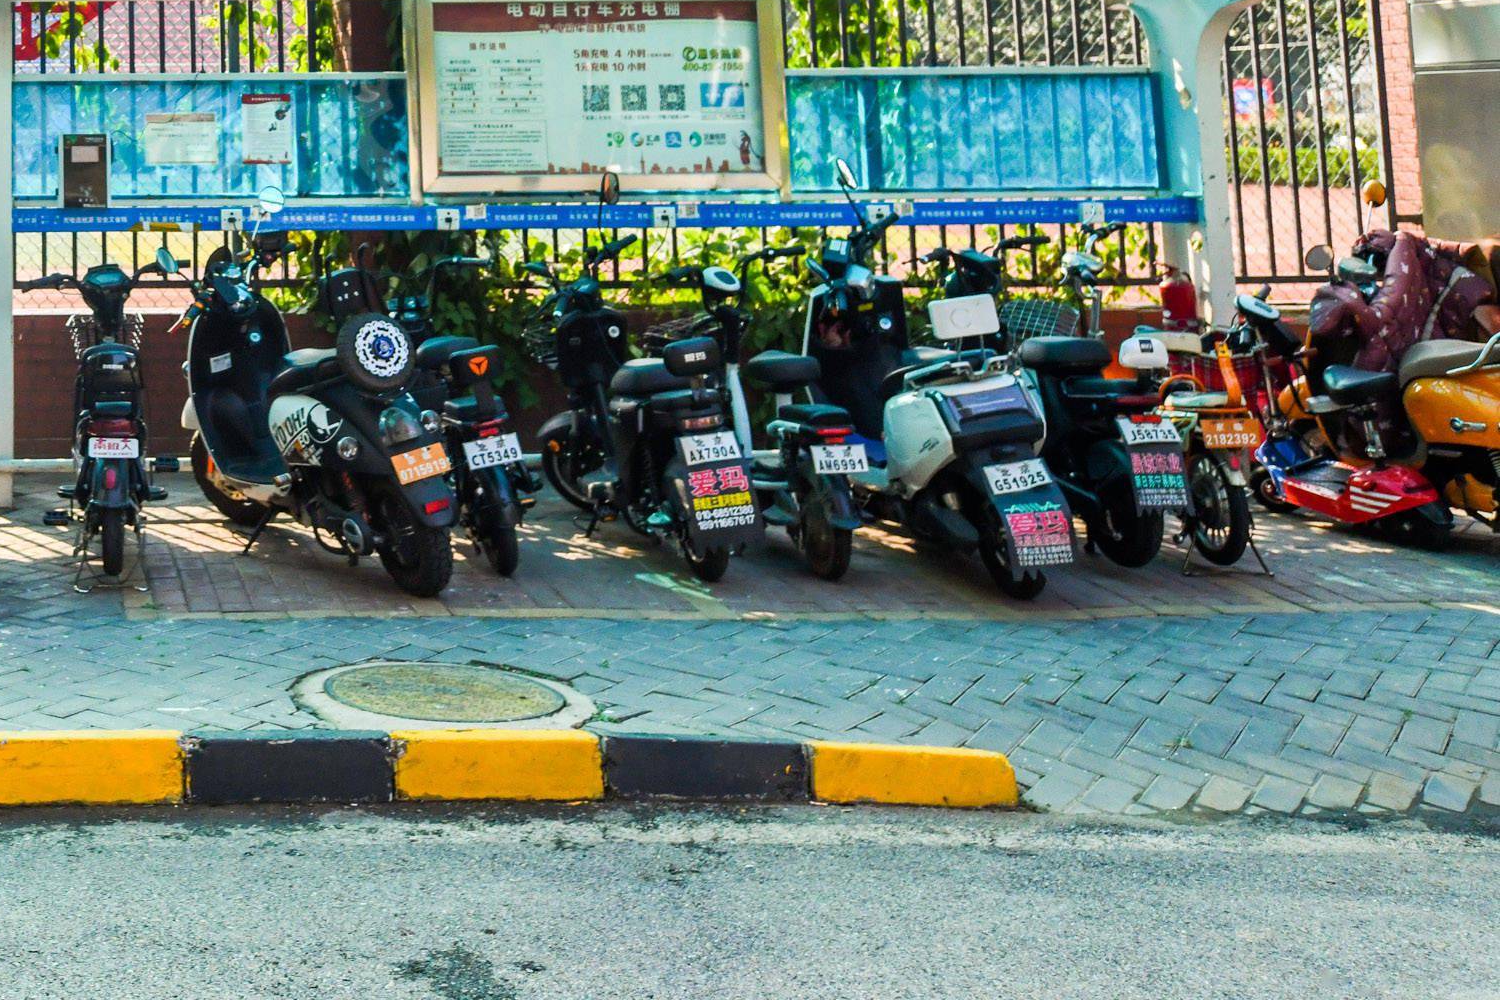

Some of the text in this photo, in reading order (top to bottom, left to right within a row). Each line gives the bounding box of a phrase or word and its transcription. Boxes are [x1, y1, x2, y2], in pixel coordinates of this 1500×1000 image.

[507, 2, 681, 17] 电动自行车充电棚
[612, 63, 624, 72] 10
[471, 447, 518, 467] CT5349
[690, 445, 736, 462] AX7904
[819, 458, 865, 471] AM6991
[688, 465, 750, 498] 爱玛
[994, 471, 1046, 492] G51925
[1006, 511, 1069, 537] 爱玛
